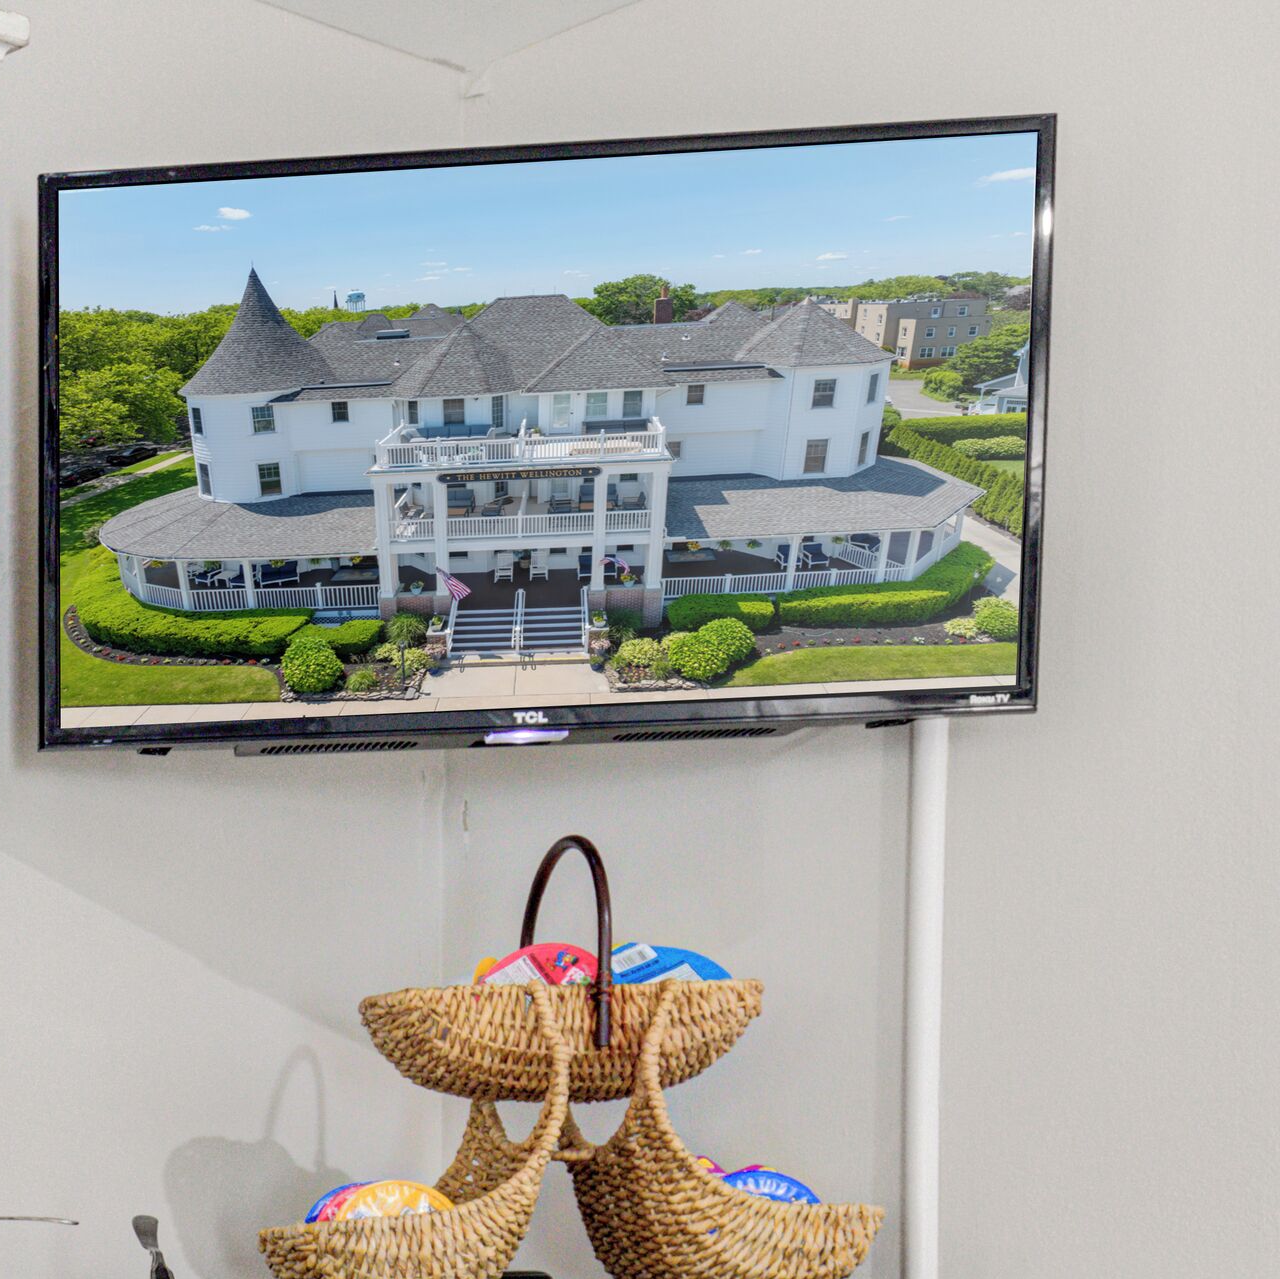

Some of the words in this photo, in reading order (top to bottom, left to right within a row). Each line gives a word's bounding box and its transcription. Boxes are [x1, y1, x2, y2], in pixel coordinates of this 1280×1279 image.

[479, 472, 517, 480] HEWITT
[519, 469, 583, 479] WELLINGTON
[995, 693, 1011, 704] TV
[513, 711, 549, 724] TCL
